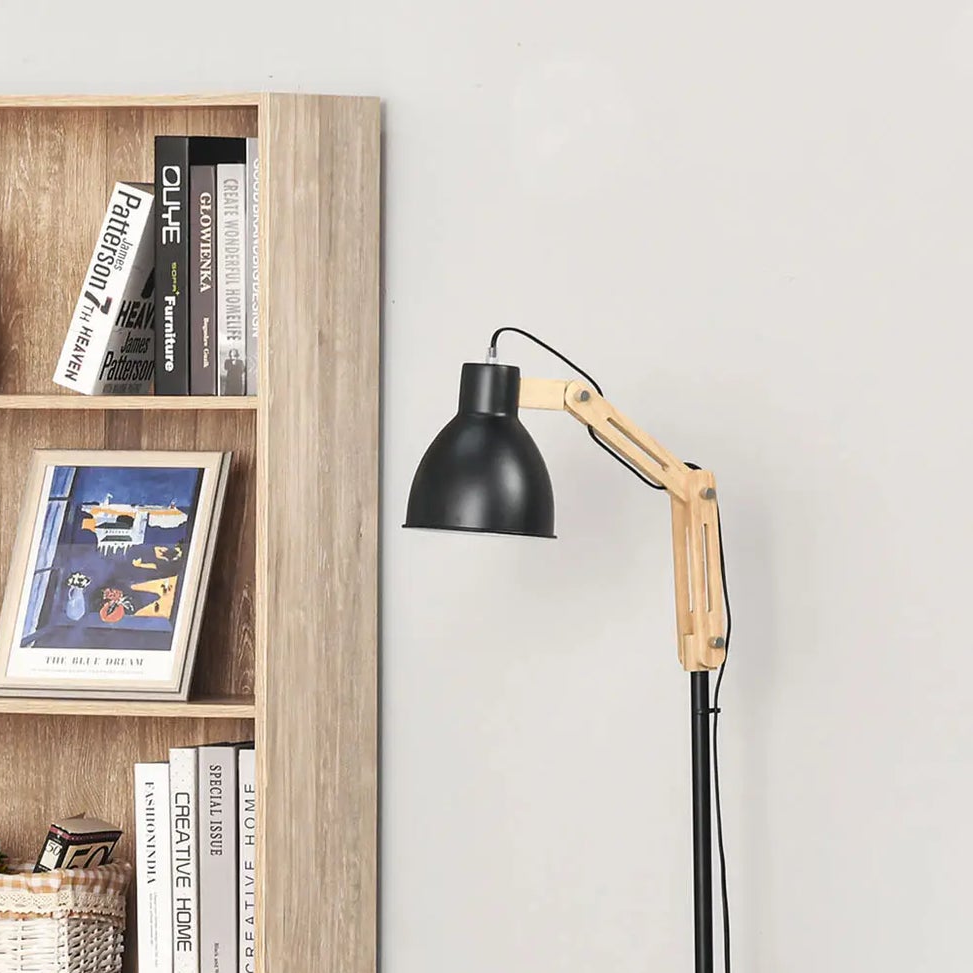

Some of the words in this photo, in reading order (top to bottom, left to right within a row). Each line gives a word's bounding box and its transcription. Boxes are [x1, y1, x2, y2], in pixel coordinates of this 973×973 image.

[223, 178, 239, 216] CREATE
[88, 190, 142, 290] Patterson
[113, 238, 133, 271] James
[224, 219, 240, 285] WONDERFUL
[115, 299, 155, 330] HEAV
[164, 296, 176, 372] Furniture
[225, 289, 242, 341] HOMELIFE
[64, 326, 93, 381] HEAVEN
[99, 351, 155, 381] Patterson
[121, 332, 150, 354] James
[46, 656, 67, 665] THE
[106, 657, 144, 667] DREAM
[209, 764, 222, 816] SPECIAL
[175, 792, 192, 888] CREATIVE
[210, 820, 223, 856] ISSUE
[176, 898, 193, 952] HOME
